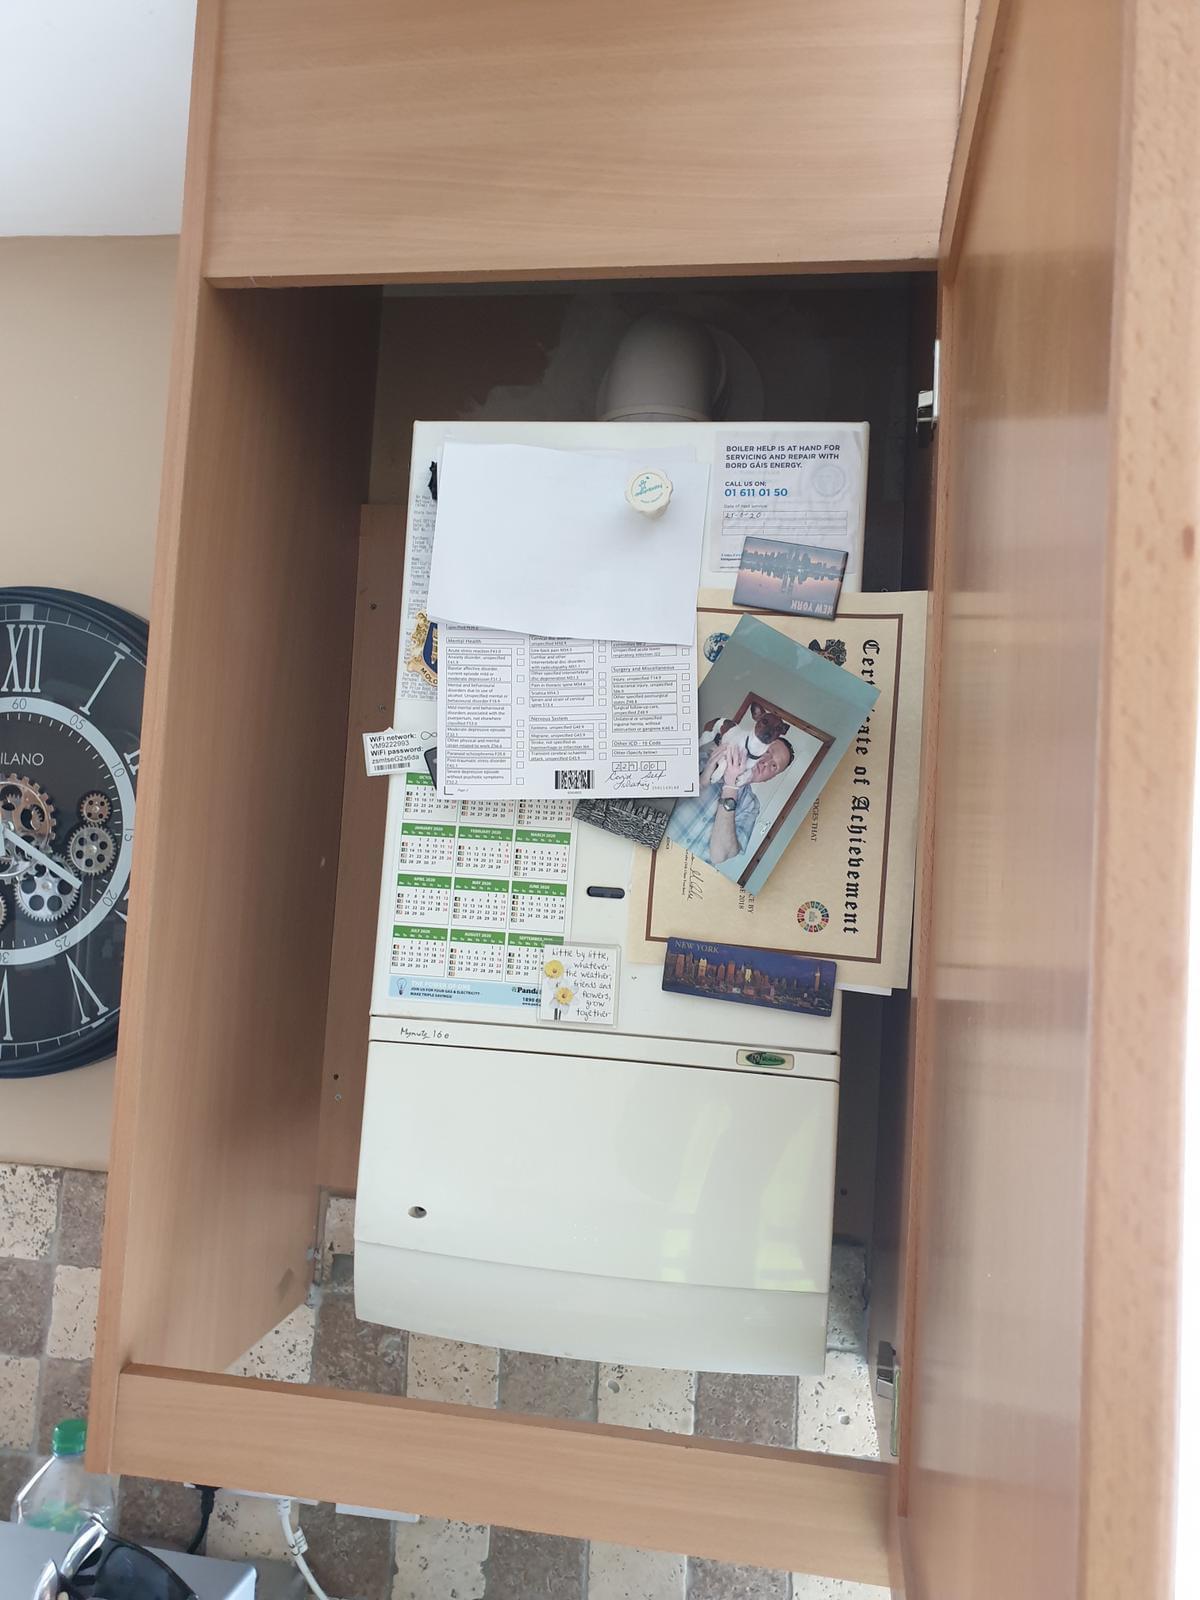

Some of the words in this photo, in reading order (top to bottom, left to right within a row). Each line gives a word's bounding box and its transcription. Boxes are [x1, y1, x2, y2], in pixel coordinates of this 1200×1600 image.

[749, 461, 768, 469] GÁIS
[724, 488, 736, 497] 01
[739, 488, 755, 497] 611
[758, 488, 770, 497] 01
[773, 488, 788, 497] 50
[790, 599, 813, 612] YORK
[814, 603, 834, 616] NEW
[1, 624, 45, 692] XII
[12, 698, 27, 710] 60
[69, 714, 87, 730] 05
[387, 733, 416, 741] network:
[388, 746, 424, 756] password:
[0, 752, 45, 766] ILANO
[111, 761, 125, 778] 10
[853, 766, 870, 785] of
[843, 796, 870, 934] Achievement
[102, 889, 118, 907] 20
[55, 935, 71, 951] 25
[675, 940, 695, 950] NEW
[697, 943, 720, 953] YORK
[576, 950, 585, 961] by
[586, 1002, 605, 1010] grow
[577, 1008, 612, 1022] together
